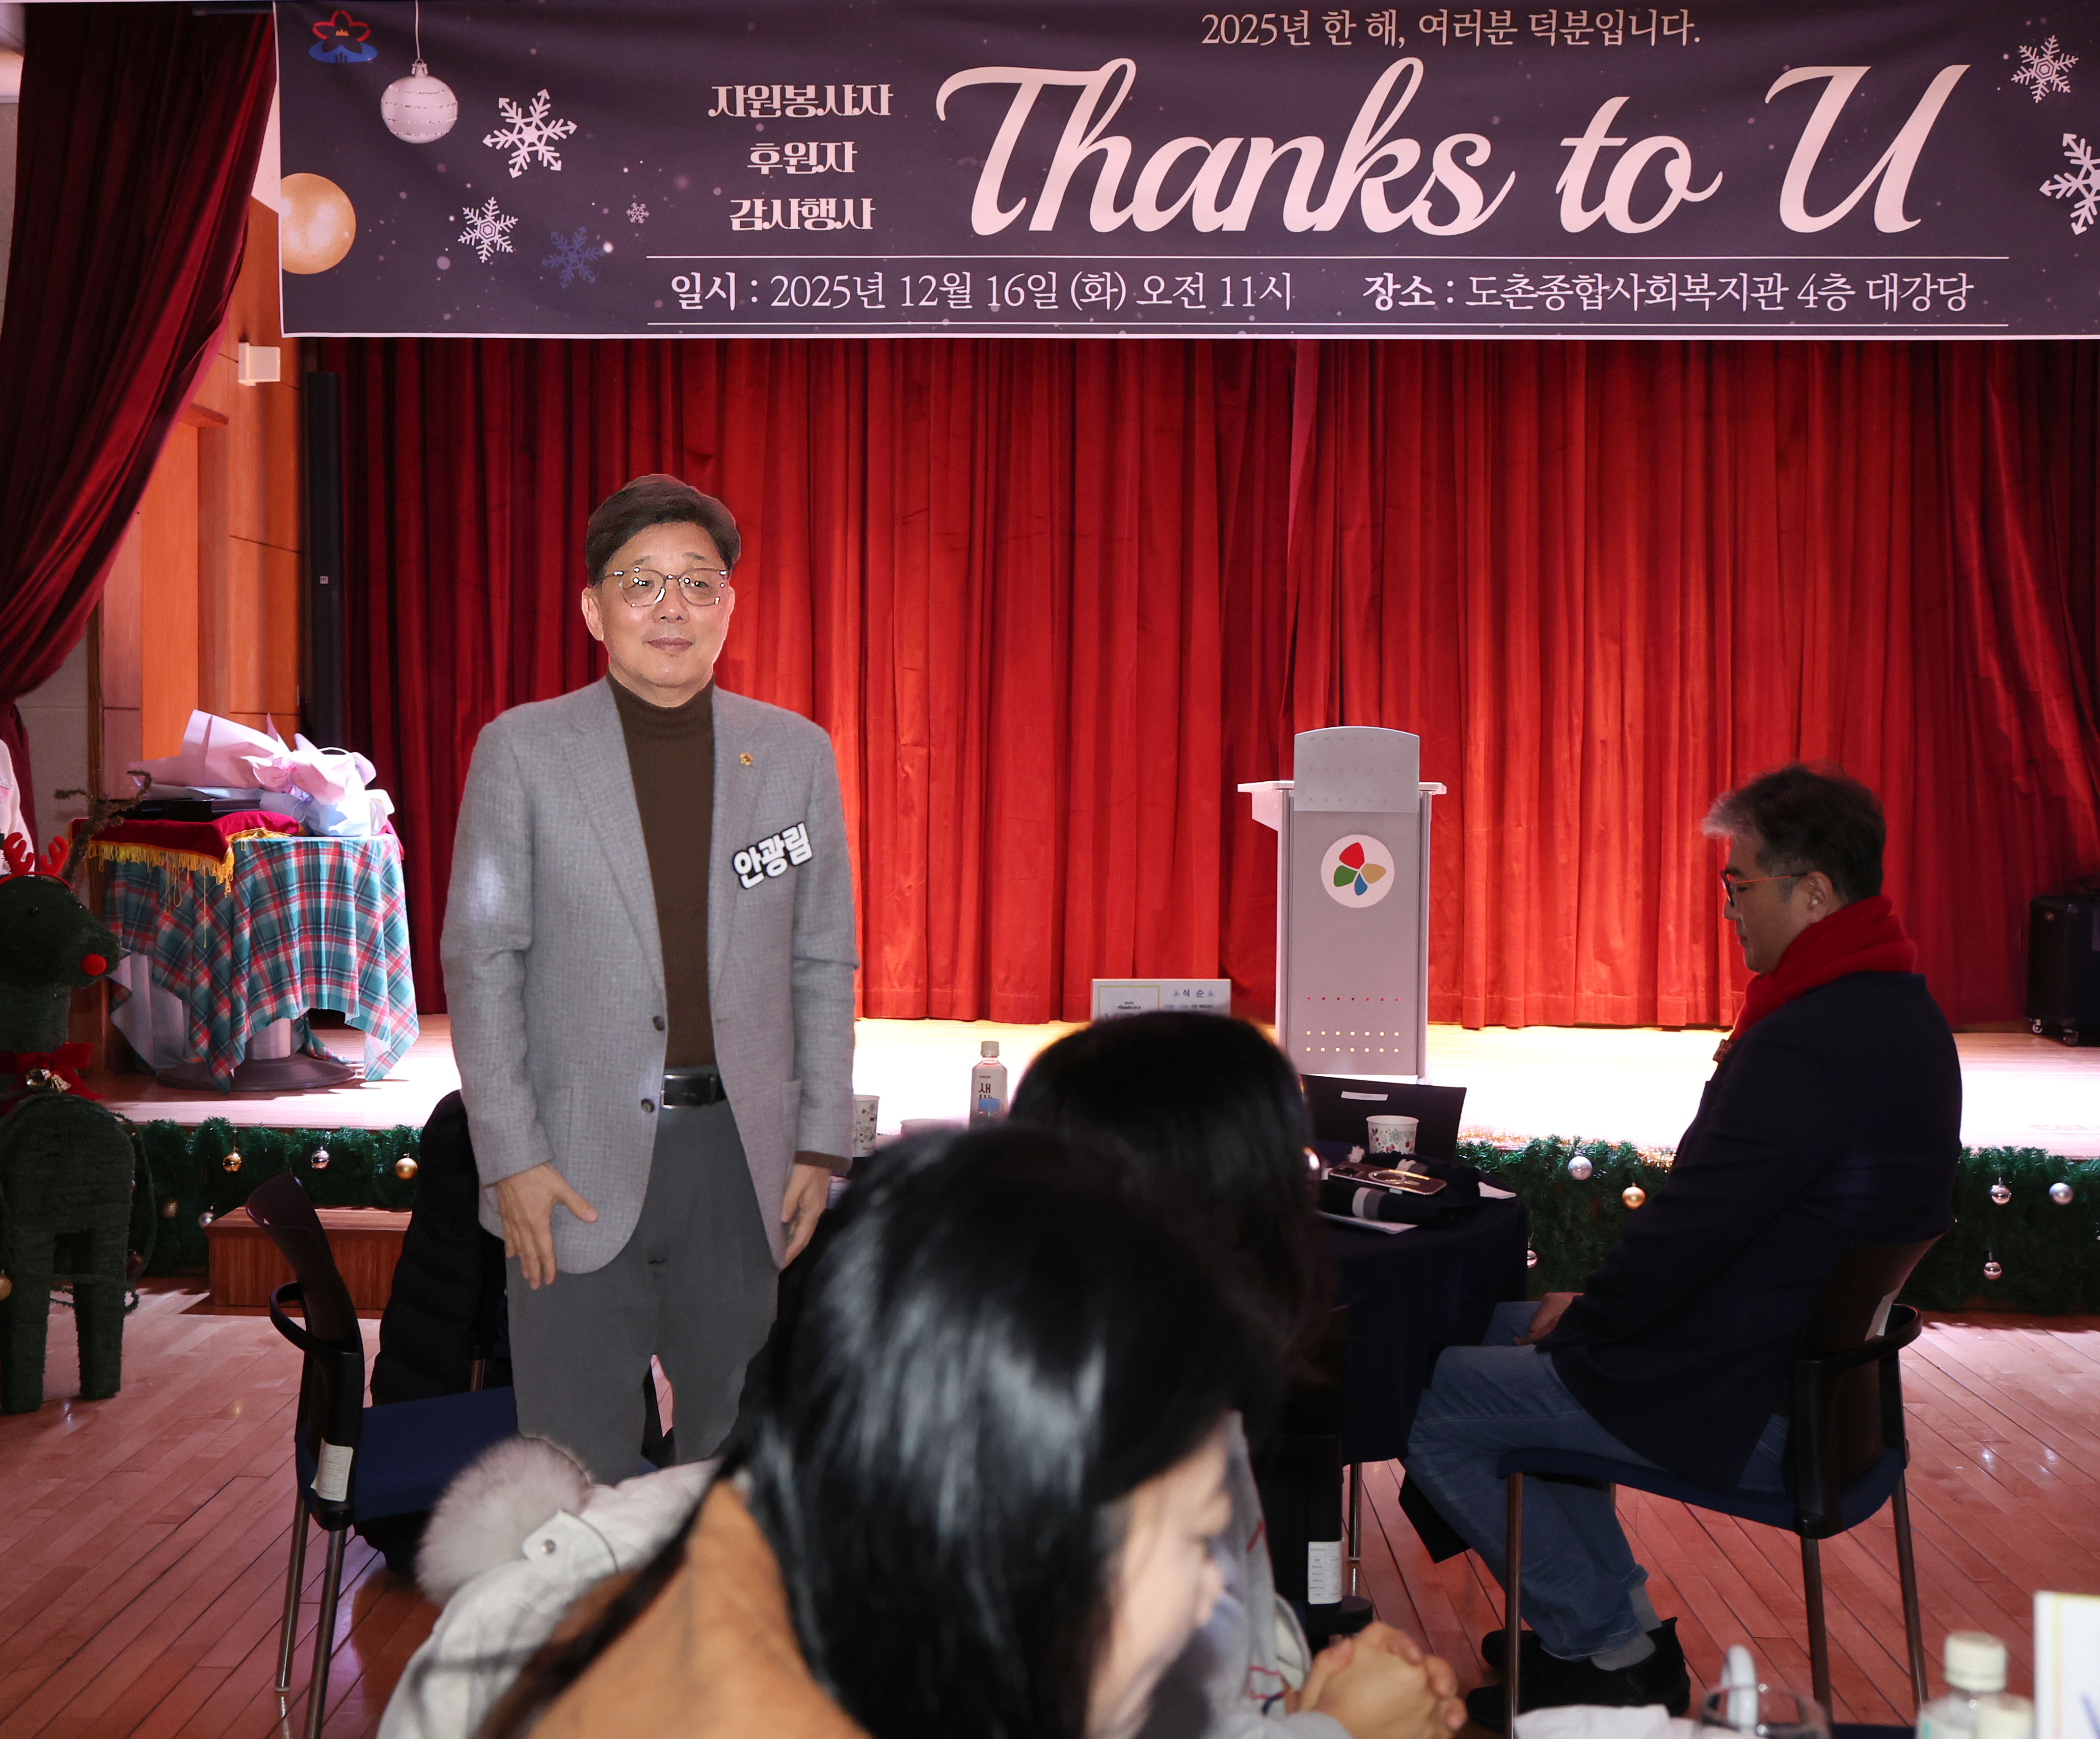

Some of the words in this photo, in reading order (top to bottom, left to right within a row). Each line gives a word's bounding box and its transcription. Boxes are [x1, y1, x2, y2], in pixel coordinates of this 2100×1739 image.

[1201, 10, 1311, 46] 2025년
[1322, 10, 1357, 45] 한
[1365, 9, 1405, 48] 해,
[1419, 9, 1518, 47] 여러분
[1529, 9, 1701, 46] 덕분입니다.
[708, 84, 894, 118] 자원봉사자
[747, 141, 858, 175] 후원자
[936, 57, 1516, 236] Thanks
[1555, 96, 1723, 234] to
[1765, 65, 1971, 233] U
[729, 198, 876, 231] 감사행사
[671, 271, 736, 311] 일시
[770, 271, 886, 309] 2025년
[900, 271, 973, 309] 12월
[987, 271, 1059, 309] 16일
[1070, 270, 1126, 311] (화)
[1136, 271, 1207, 309] 오전
[1221, 272, 1290, 311] 11시
[1362, 272, 1436, 311] 장소
[1465, 272, 1789, 312] 도촌종합사회복지관
[1797, 273, 1856, 312] 4층
[1865, 273, 1975, 312] 대강당
[734, 822, 813, 889] 안광림
